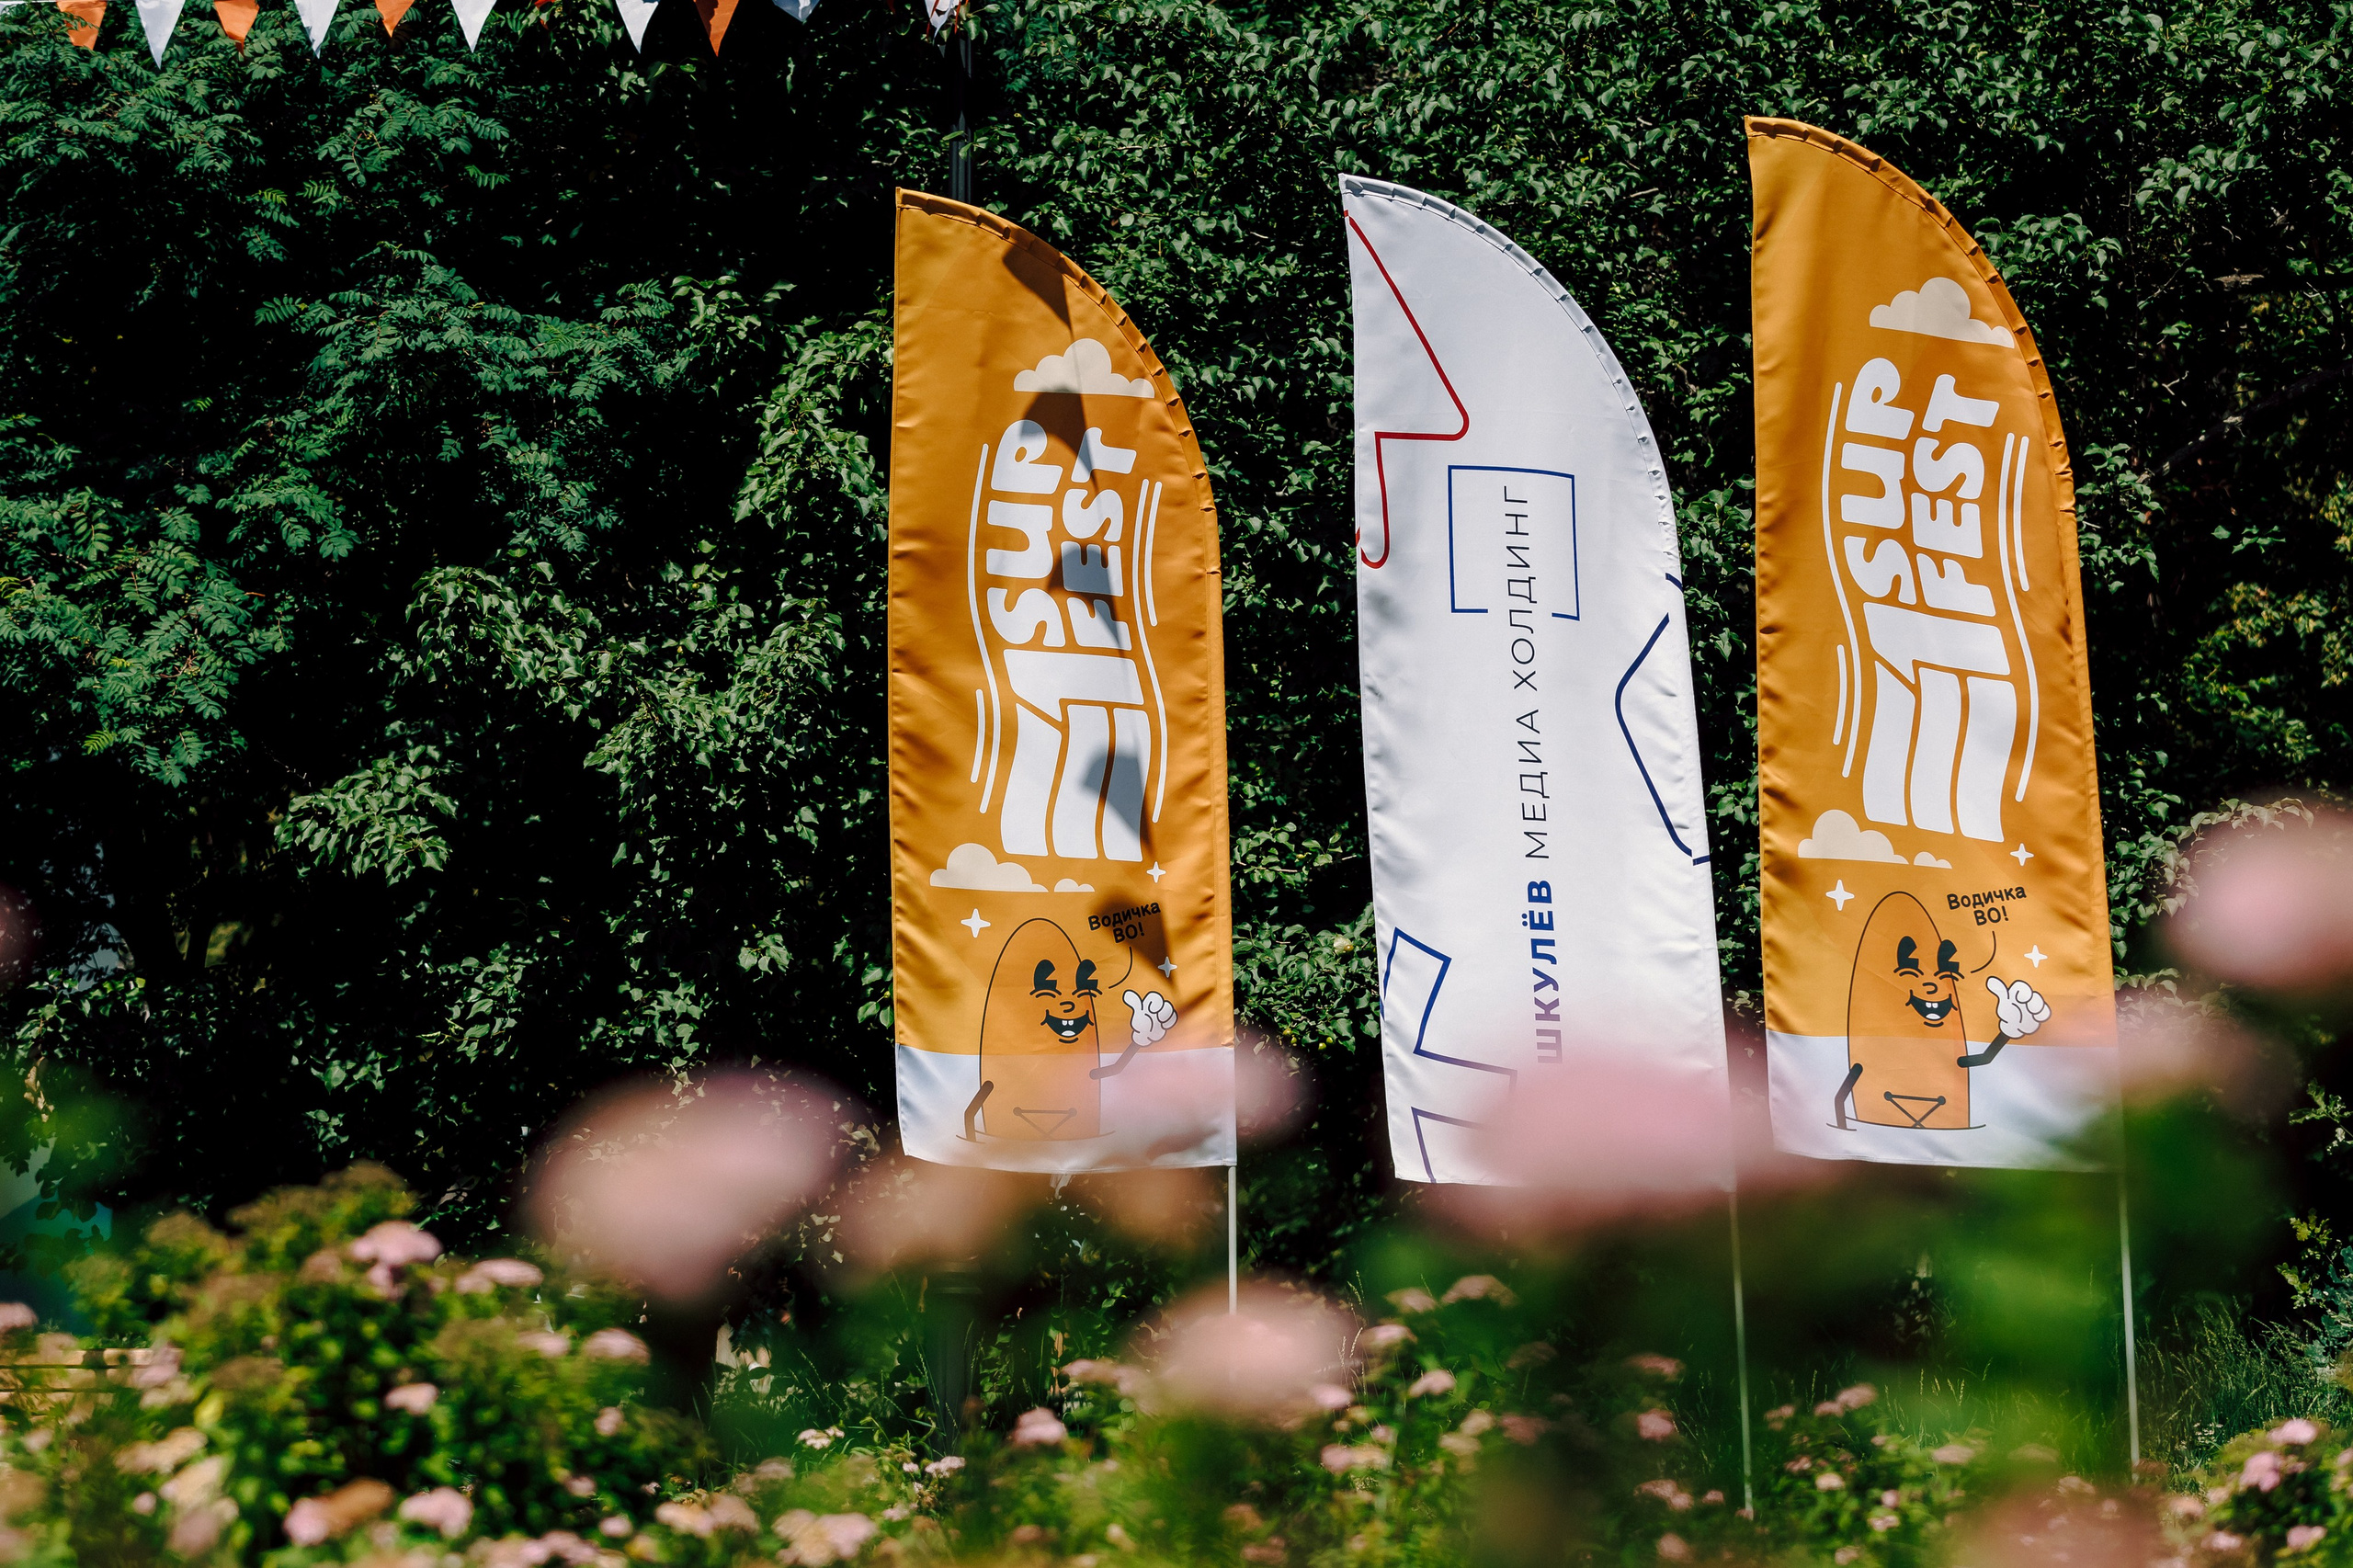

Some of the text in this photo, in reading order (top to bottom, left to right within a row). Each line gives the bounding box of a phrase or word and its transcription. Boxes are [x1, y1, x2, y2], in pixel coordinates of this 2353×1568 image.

[986, 419, 1065, 648] SUP
[1061, 426, 1138, 651] FEST
[1841, 358, 1916, 607] SUP
[1912, 373, 2000, 618] FEST
[1504, 484, 1563, 1065] ШКУЛЁВ МЕДИА ХОЛДИНГ
[1087, 902, 1162, 931] Водичка
[1112, 921, 1145, 944] ВО!
[1946, 886, 2028, 911] Водичка
[1973, 905, 2009, 926] ВО!
